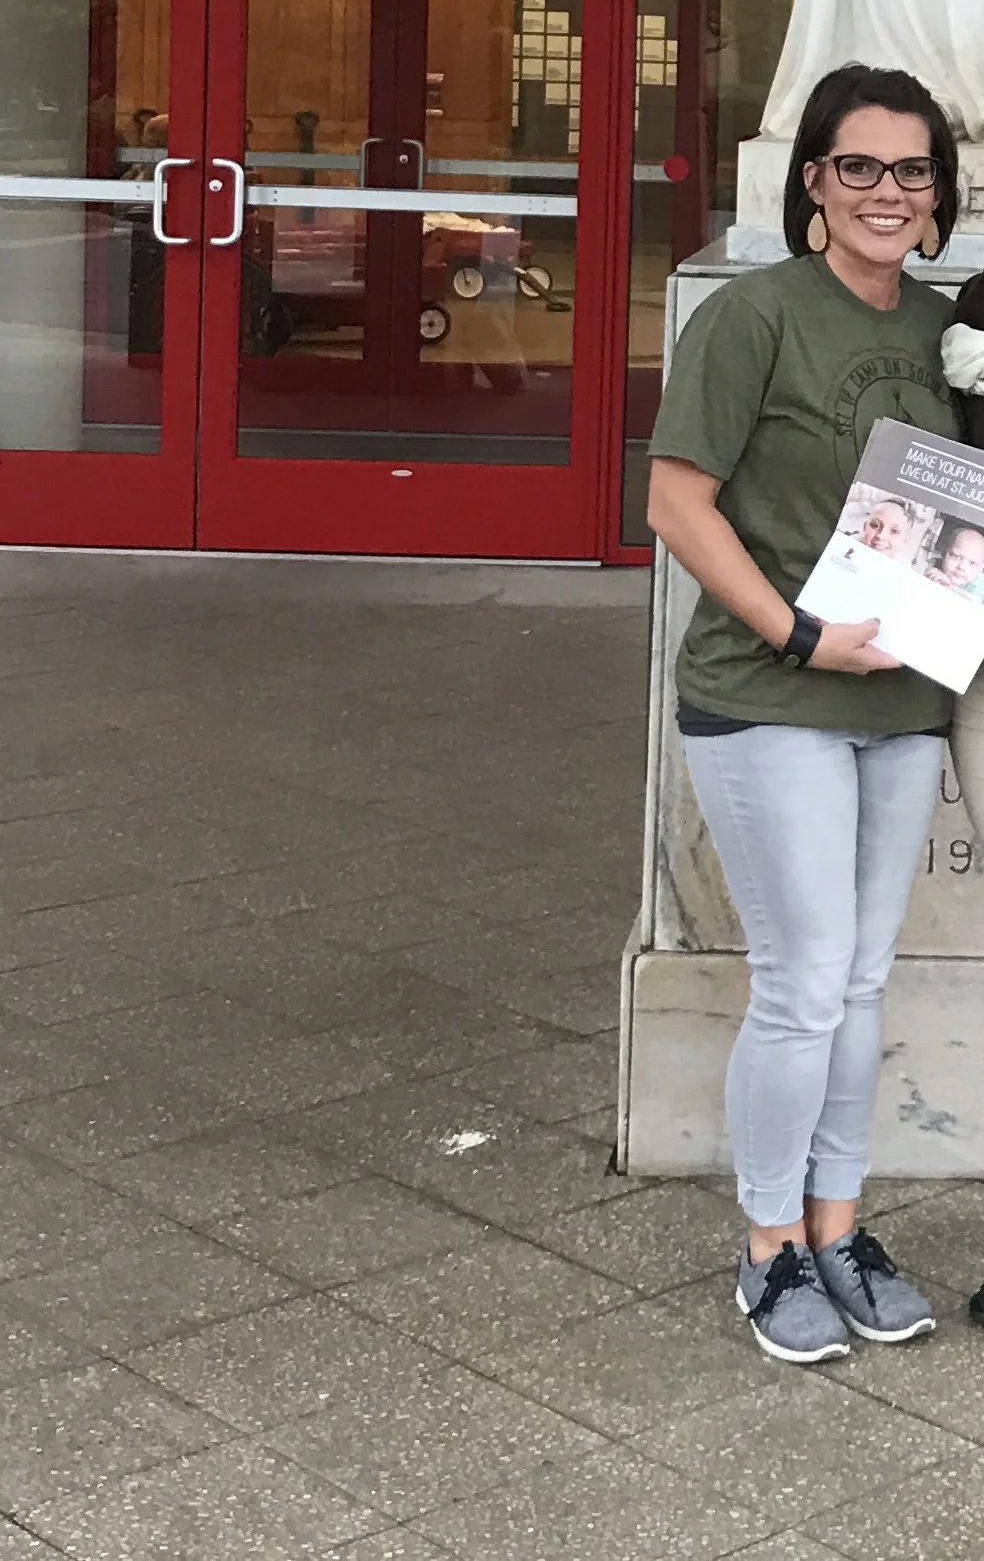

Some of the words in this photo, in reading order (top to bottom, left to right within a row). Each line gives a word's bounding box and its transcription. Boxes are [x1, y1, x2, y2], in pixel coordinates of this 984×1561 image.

[884, 359, 900, 376] ON
[905, 448, 938, 469] MAKE
[939, 459, 966, 478] YOUR
[899, 463, 922, 480] LIVE
[921, 471, 938, 485] ON
[936, 477, 951, 489] AT
[951, 481, 967, 495] ST.
